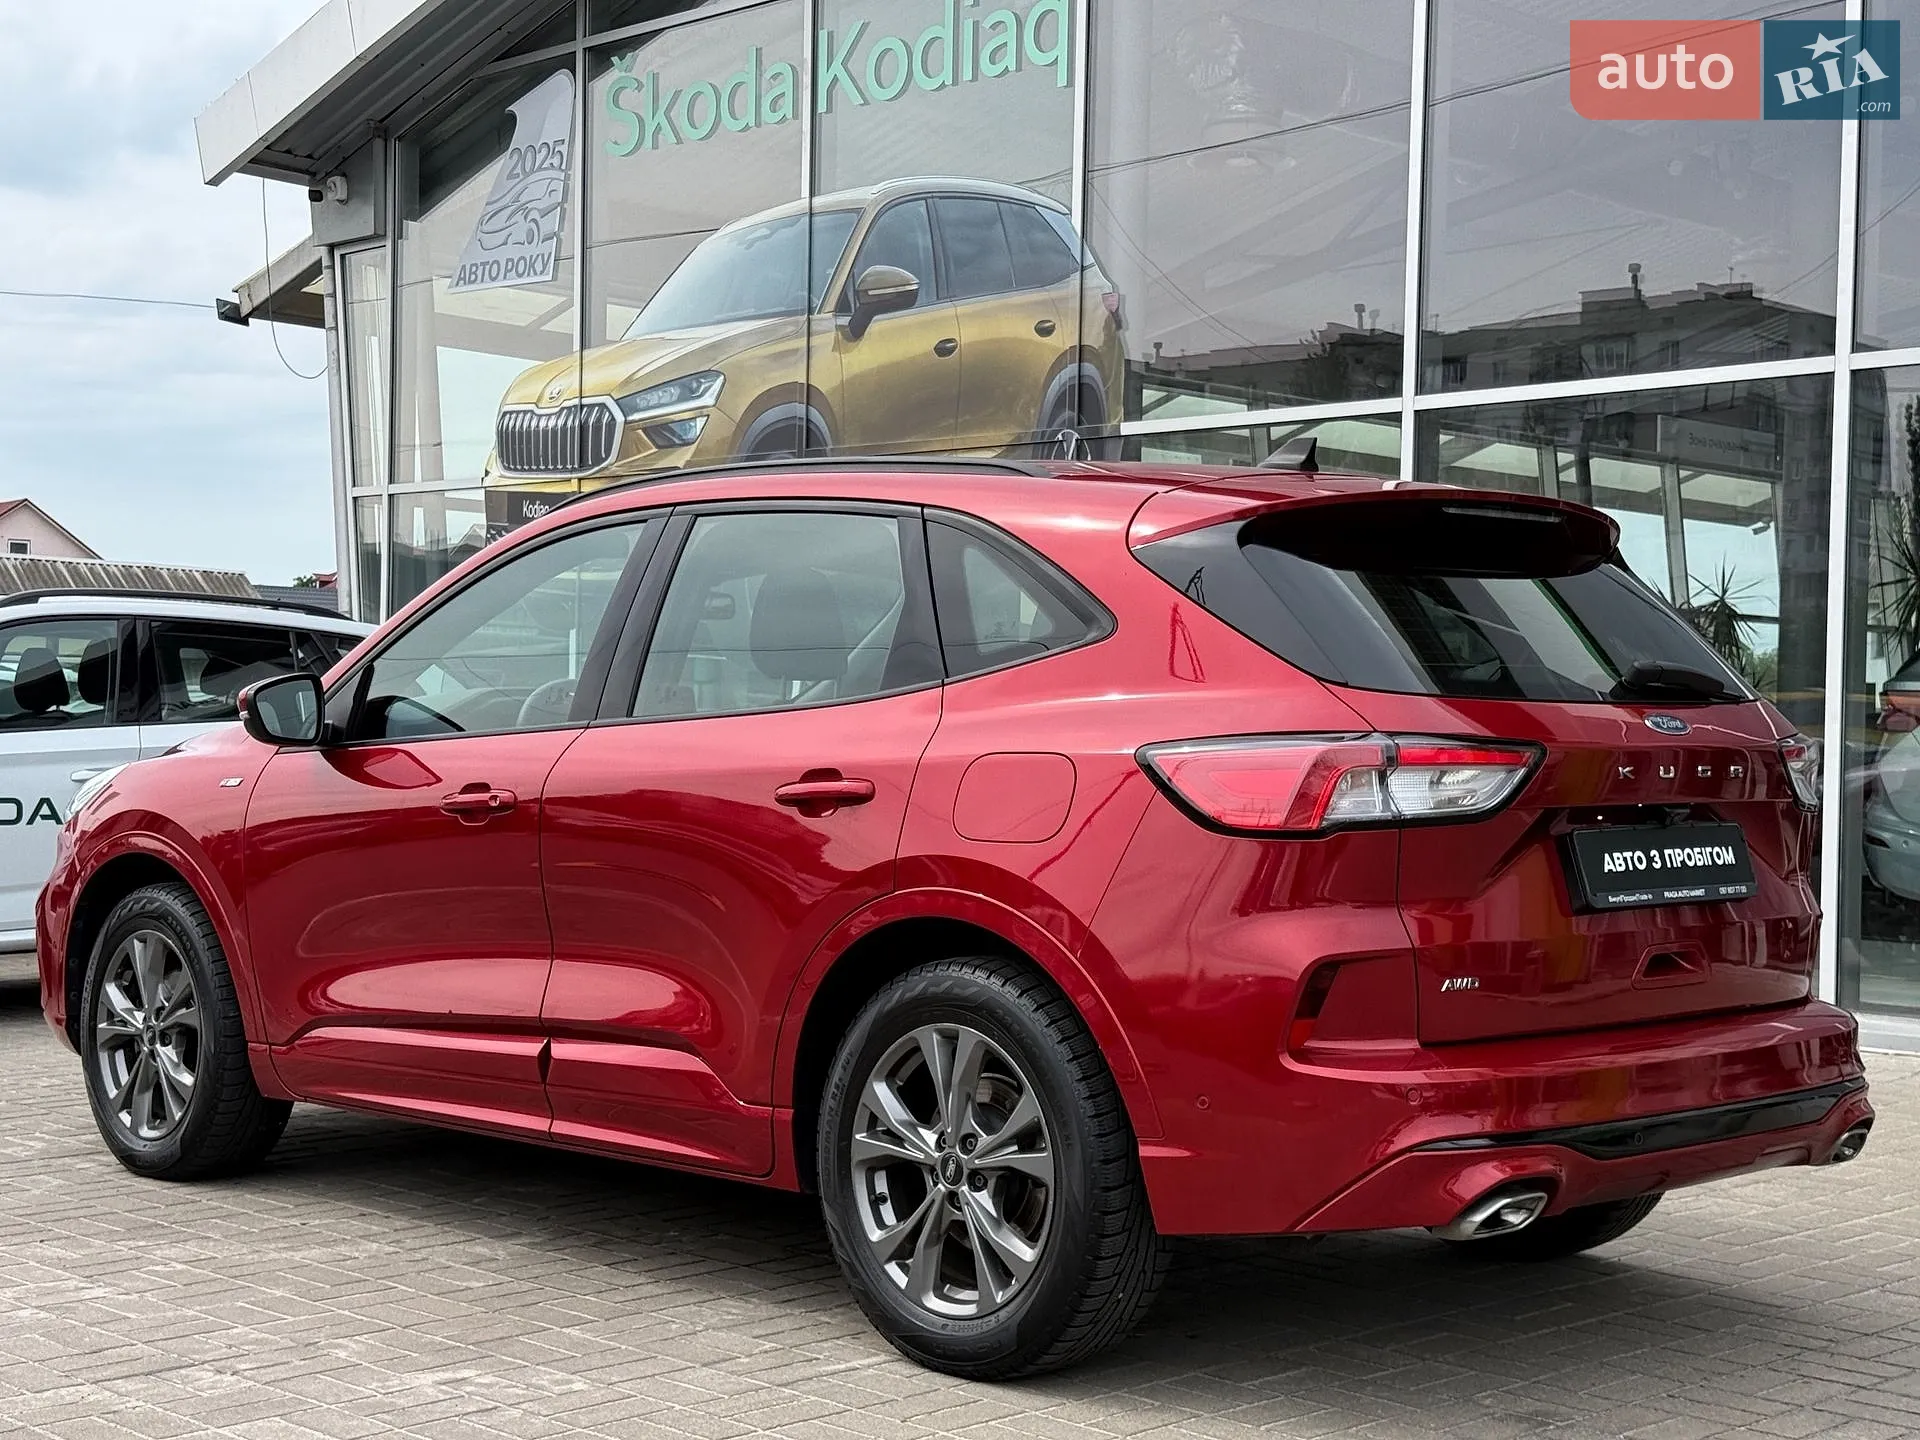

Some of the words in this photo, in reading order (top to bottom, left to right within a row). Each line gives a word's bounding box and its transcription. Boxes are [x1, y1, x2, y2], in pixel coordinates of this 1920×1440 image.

[605, 46, 797, 157] Škoda
[818, 0, 1069, 114] Kodiaq
[506, 138, 565, 180] 2025
[455, 259, 501, 288] АВТО
[503, 251, 553, 280] РОКУ
[1617, 765, 1744, 780] KUGA
[1603, 849, 1647, 873] АВТО
[1650, 851, 1662, 870] З
[1663, 845, 1736, 868] ПРОБІГОМ
[1440, 977, 1480, 992] AWD
